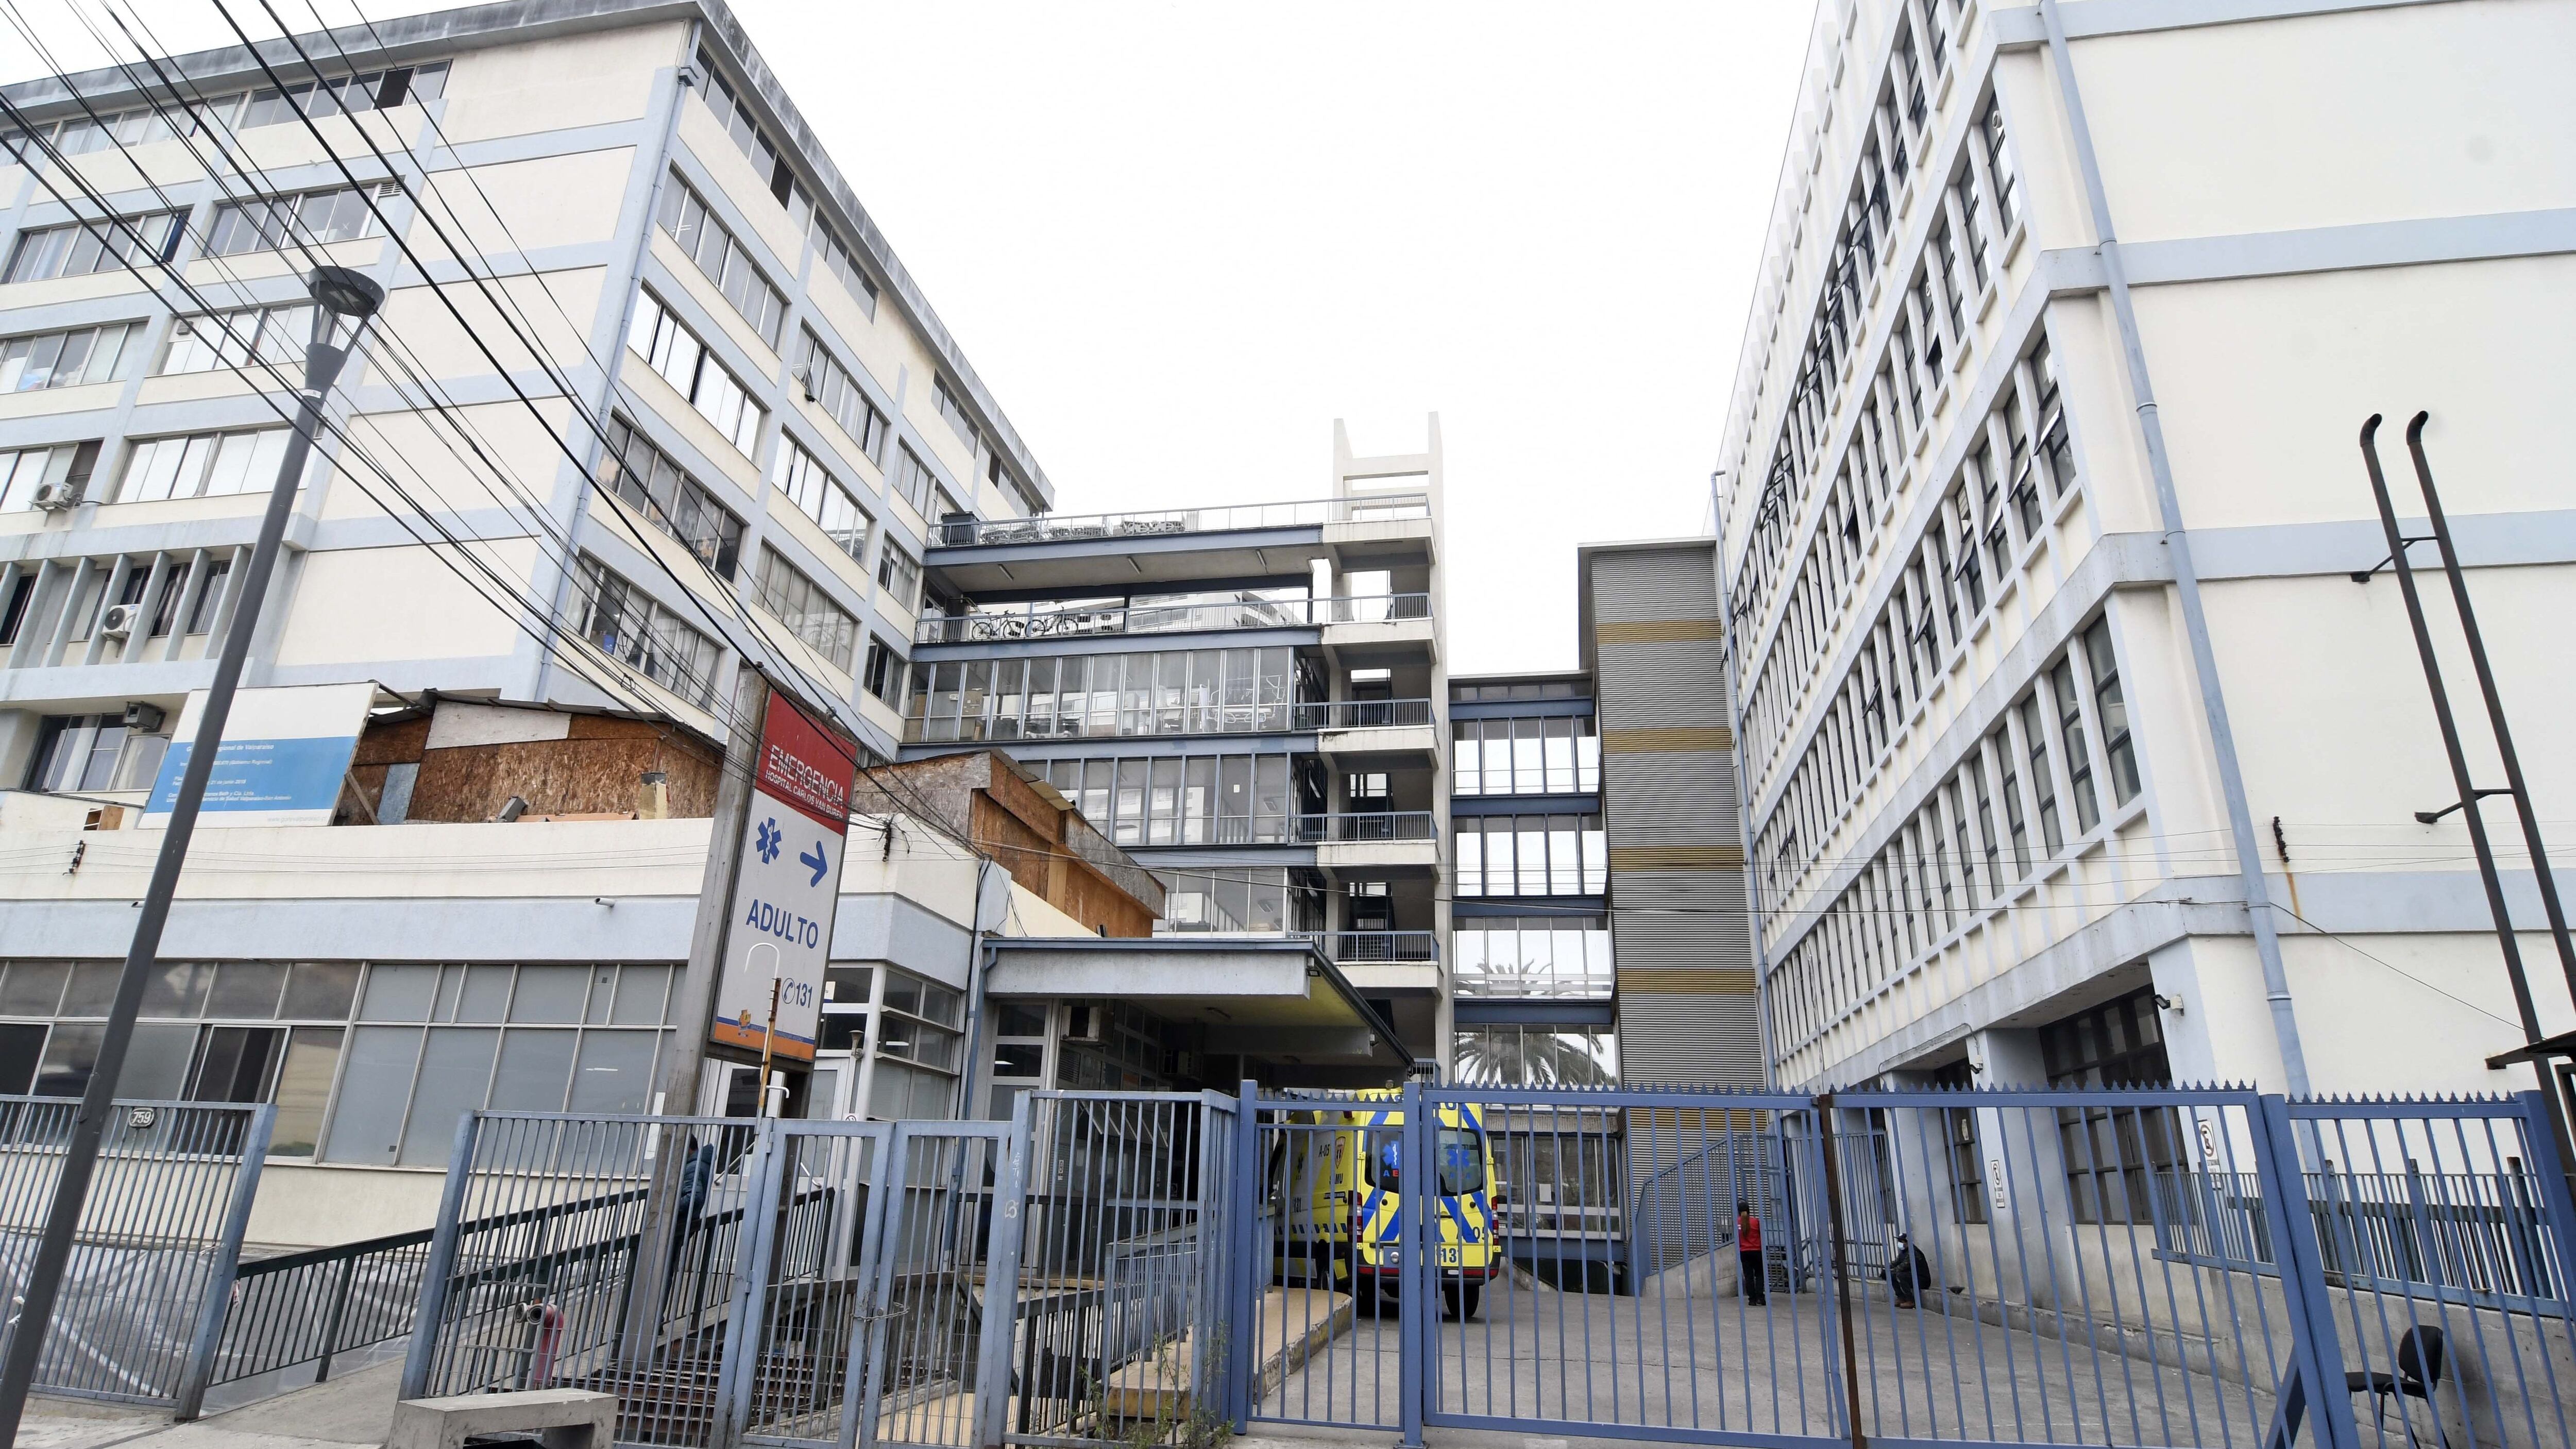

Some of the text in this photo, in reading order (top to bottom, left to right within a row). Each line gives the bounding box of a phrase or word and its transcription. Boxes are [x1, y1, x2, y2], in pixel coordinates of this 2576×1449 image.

[769, 744, 844, 809] EMERGENCIA
[765, 769, 792, 793] HOSPITAL
[793, 786, 815, 805] CARLOS
[816, 797, 825, 812] VAN
[746, 899, 818, 949] ADULTO
[796, 982, 812, 1008] 131
[132, 1111, 151, 1123] 759
[1318, 1143, 1331, 1158] A-05
[1442, 1248, 1459, 1263] 13
